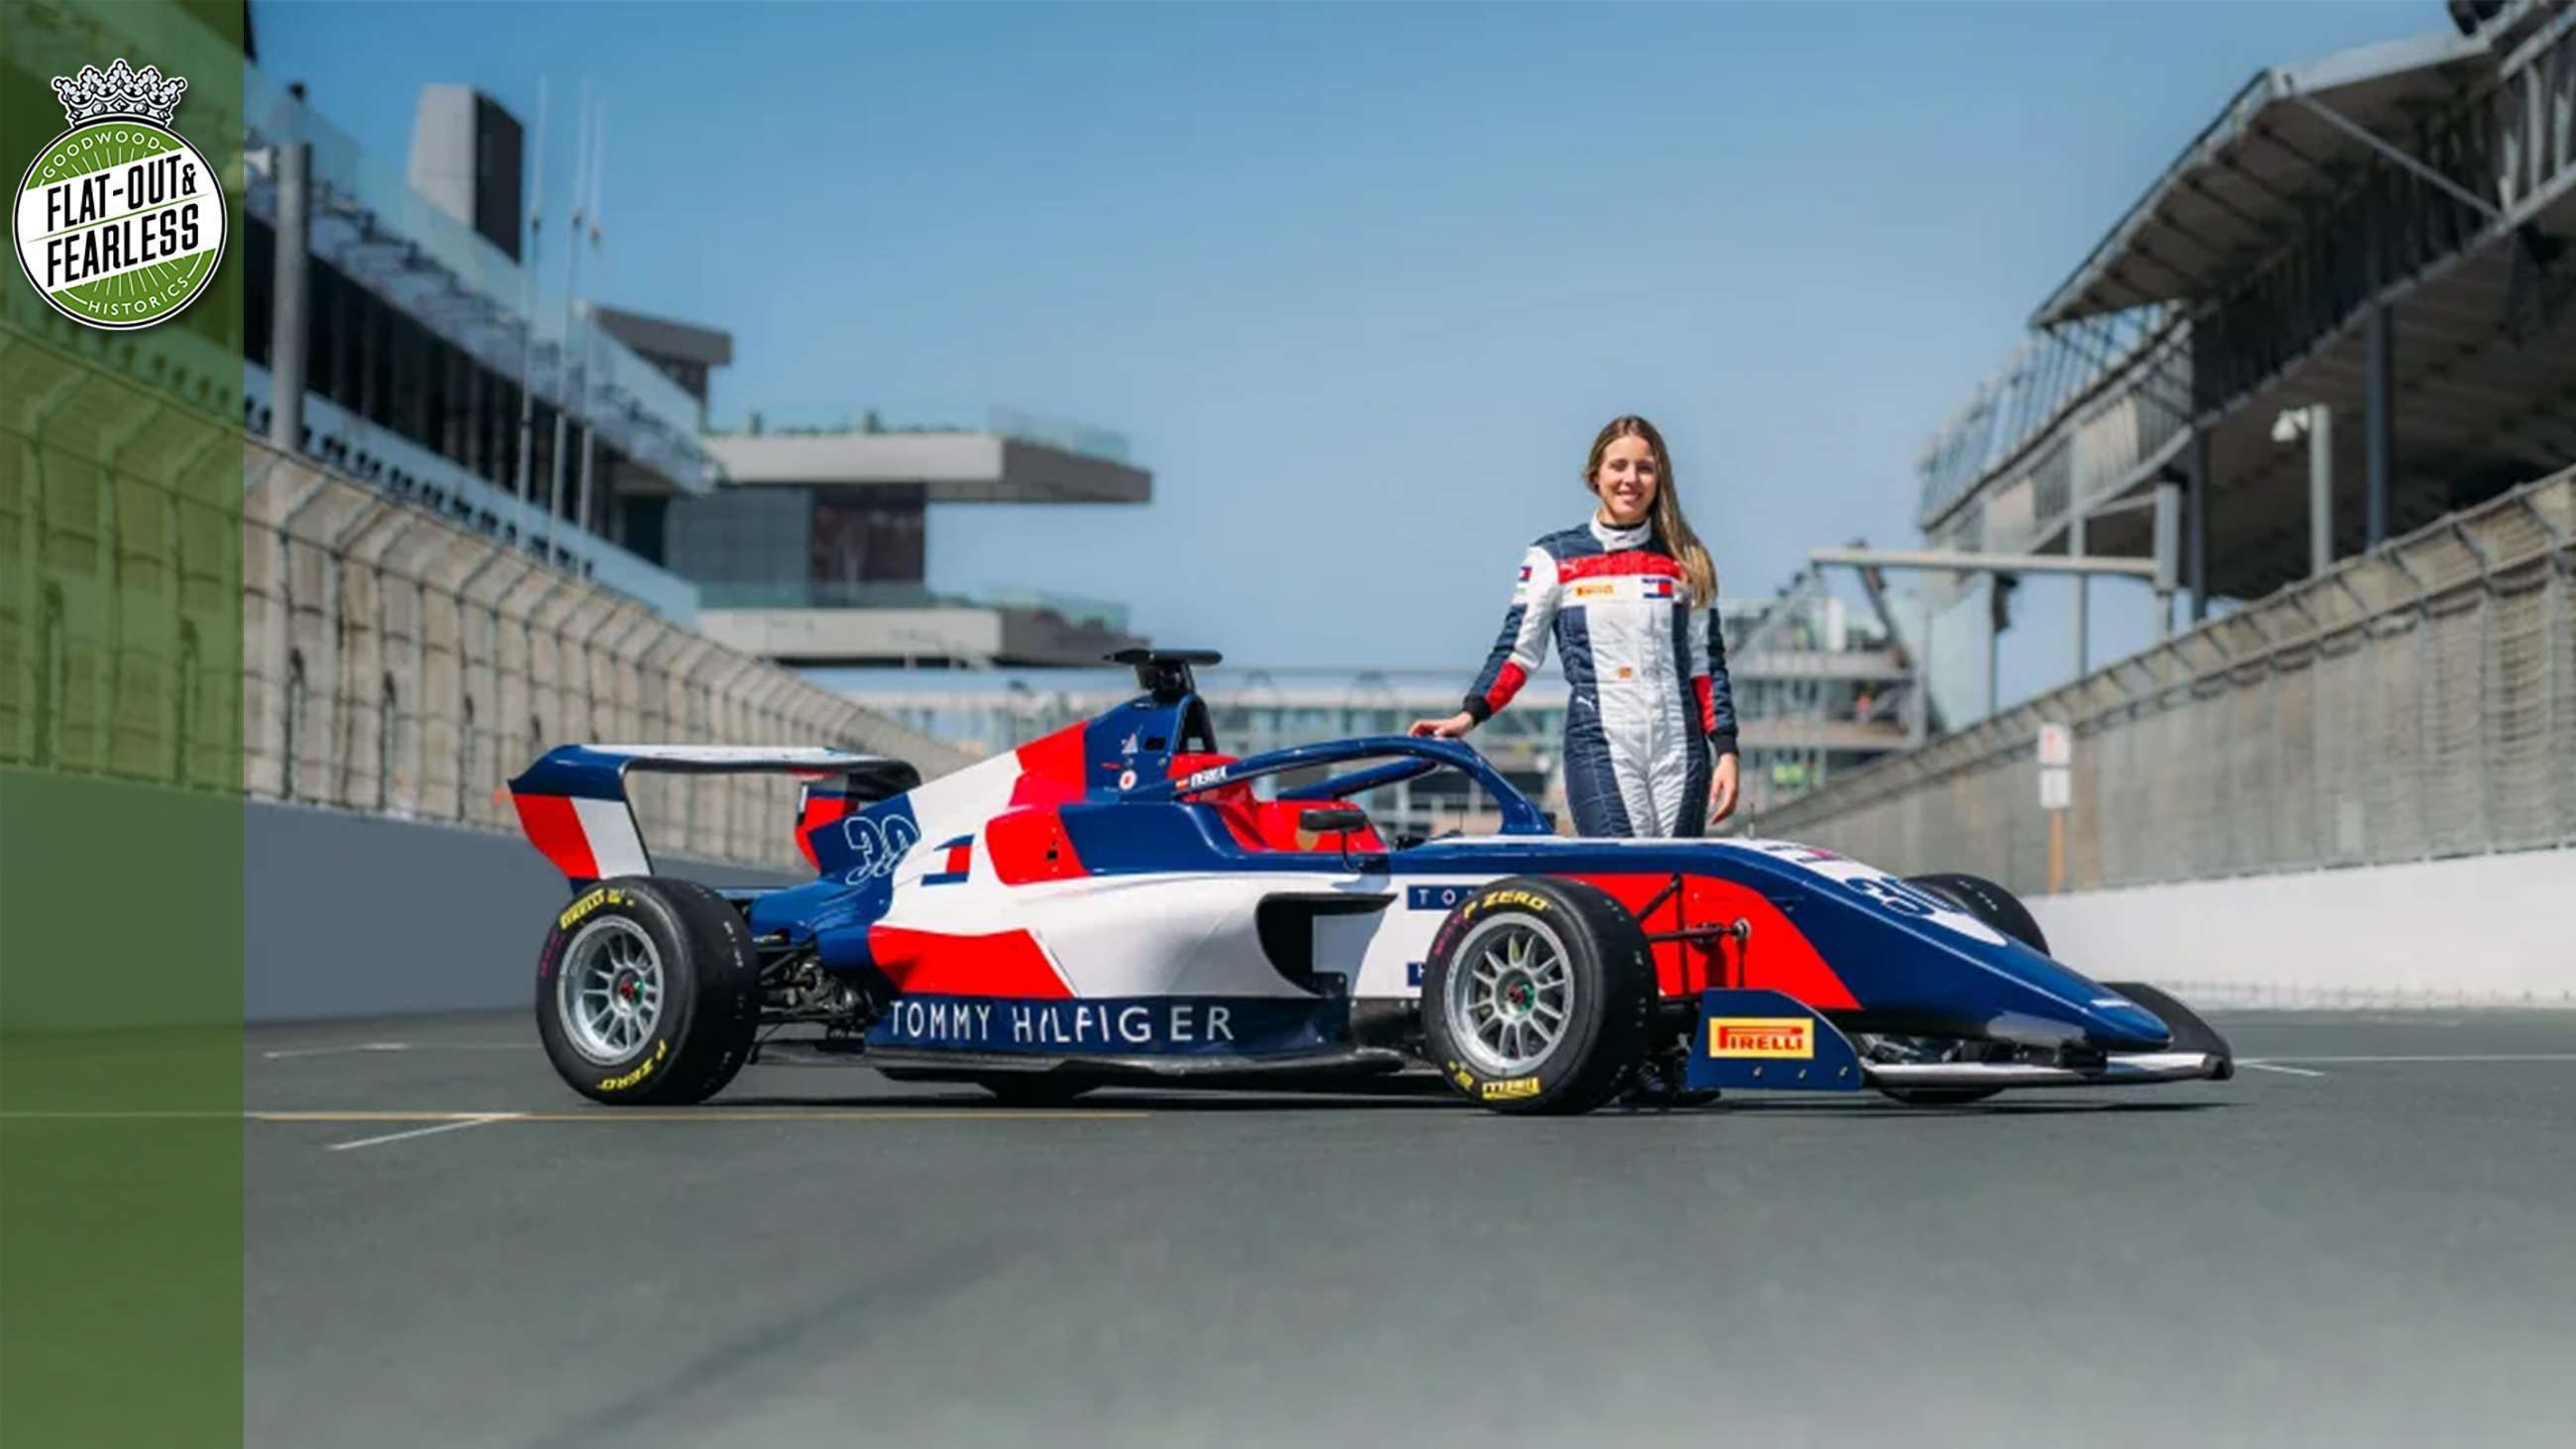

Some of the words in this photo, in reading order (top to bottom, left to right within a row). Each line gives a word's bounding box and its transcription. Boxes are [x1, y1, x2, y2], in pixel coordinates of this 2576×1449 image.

[560, 888, 604, 930] PIRELLI
[1463, 900, 1478, 919] P
[1482, 889, 1549, 911] ZERO
[889, 1000, 992, 1040] TOMMY
[1012, 1004, 1234, 1043] HILFIGER
[1717, 1025, 1805, 1052] PIRELLI
